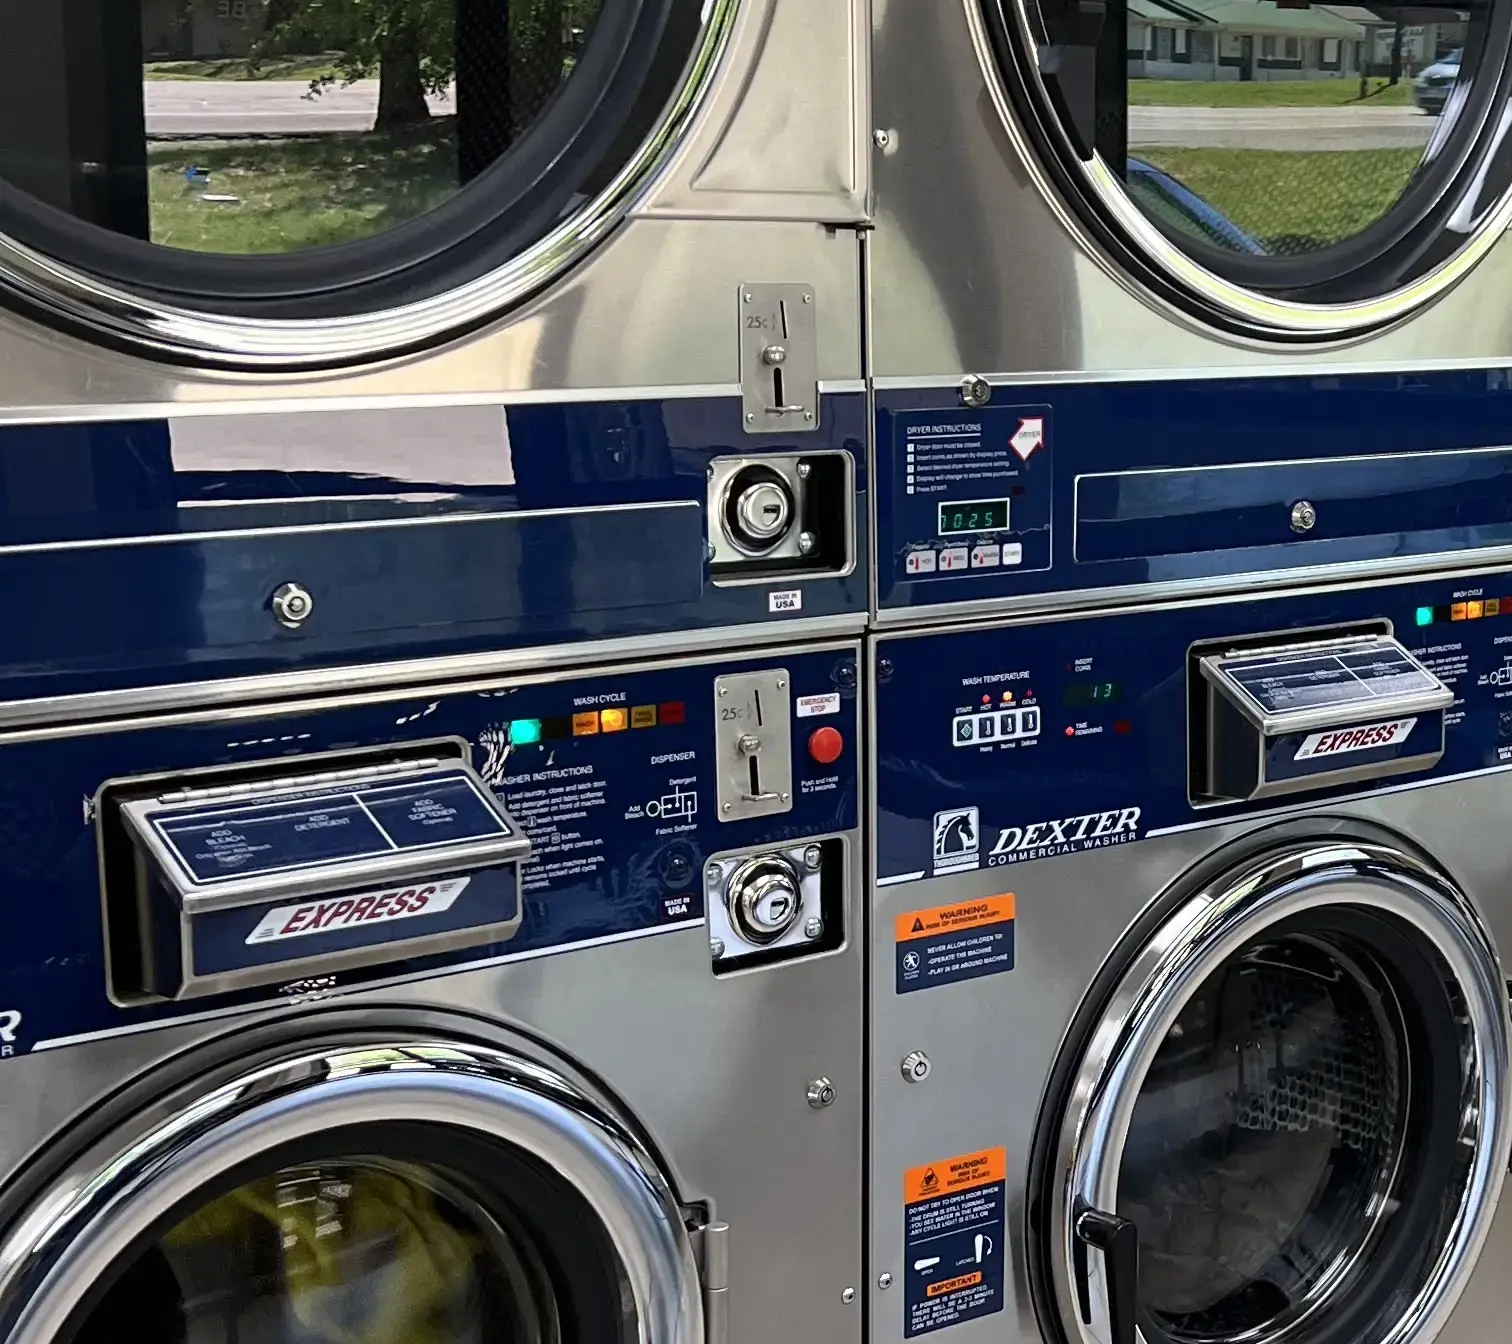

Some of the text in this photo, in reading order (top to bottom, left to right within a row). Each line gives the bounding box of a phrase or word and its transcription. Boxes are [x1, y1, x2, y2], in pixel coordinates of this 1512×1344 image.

[907, 424, 981, 434] DRYER INSTRUCTIONS
[776, 600, 795, 609] USA
[962, 671, 1030, 686] WASH TEMPERATURE
[573, 692, 626, 706] WASH CYCLE
[801, 696, 837, 706] EMERGENCY
[811, 705, 826, 713] STOP
[1312, 723, 1398, 755] EXPRESS
[651, 751, 695, 765] DISPENSER
[533, 765, 593, 781] INSTRUCTIONS
[669, 776, 697, 786] Detergent
[522, 799, 549, 808] detergent
[294, 817, 350, 831] DETERGENT
[309, 814, 329, 822] ADD
[674, 824, 697, 832] Softener
[989, 806, 1141, 855] DEXTER
[205, 835, 246, 845] BLEACH
[988, 831, 1137, 867] COMMERCIAL WASHER
[664, 897, 690, 907] MADE IN
[280, 885, 436, 936] EXPRESS
[668, 905, 687, 916] USA
[940, 904, 988, 920] WARNING
[952, 915, 977, 925] SERIOUS
[979, 911, 1000, 919] INJURY
[927, 935, 994, 954] NEVER ALLOW CHILDREN
[968, 946, 992, 956] MACHINE
[960, 953, 1008, 968] AROUND MACHINE
[950, 1157, 988, 1172] WARNING
[918, 1204, 929, 1212] NOT
[950, 1195, 965, 1203] OPEN
[966, 1191, 981, 1199] DOOR
[982, 1186, 998, 1195] WHEN
[946, 1205, 960, 1213] STILL
[962, 1198, 984, 1209] TURNING
[936, 1213, 953, 1222] WATER
[973, 1202, 996, 1212] WINDOW
[923, 1223, 940, 1232] CYCLE
[942, 1219, 957, 1228] LIGHT
[965, 1213, 979, 1221] STILL
[956, 1257, 974, 1266] LATCHED
[931, 1275, 977, 1293] IMPORTANT
[920, 1298, 940, 1308] POWER
[949, 1285, 987, 1300] INTERRUPTED
[974, 1289, 994, 1299] MINUTE
[912, 1315, 930, 1324] DELAY
[932, 1308, 954, 1318] BEFORE
[969, 1298, 985, 1308] DOOR
[936, 1312, 959, 1324] OPENED
